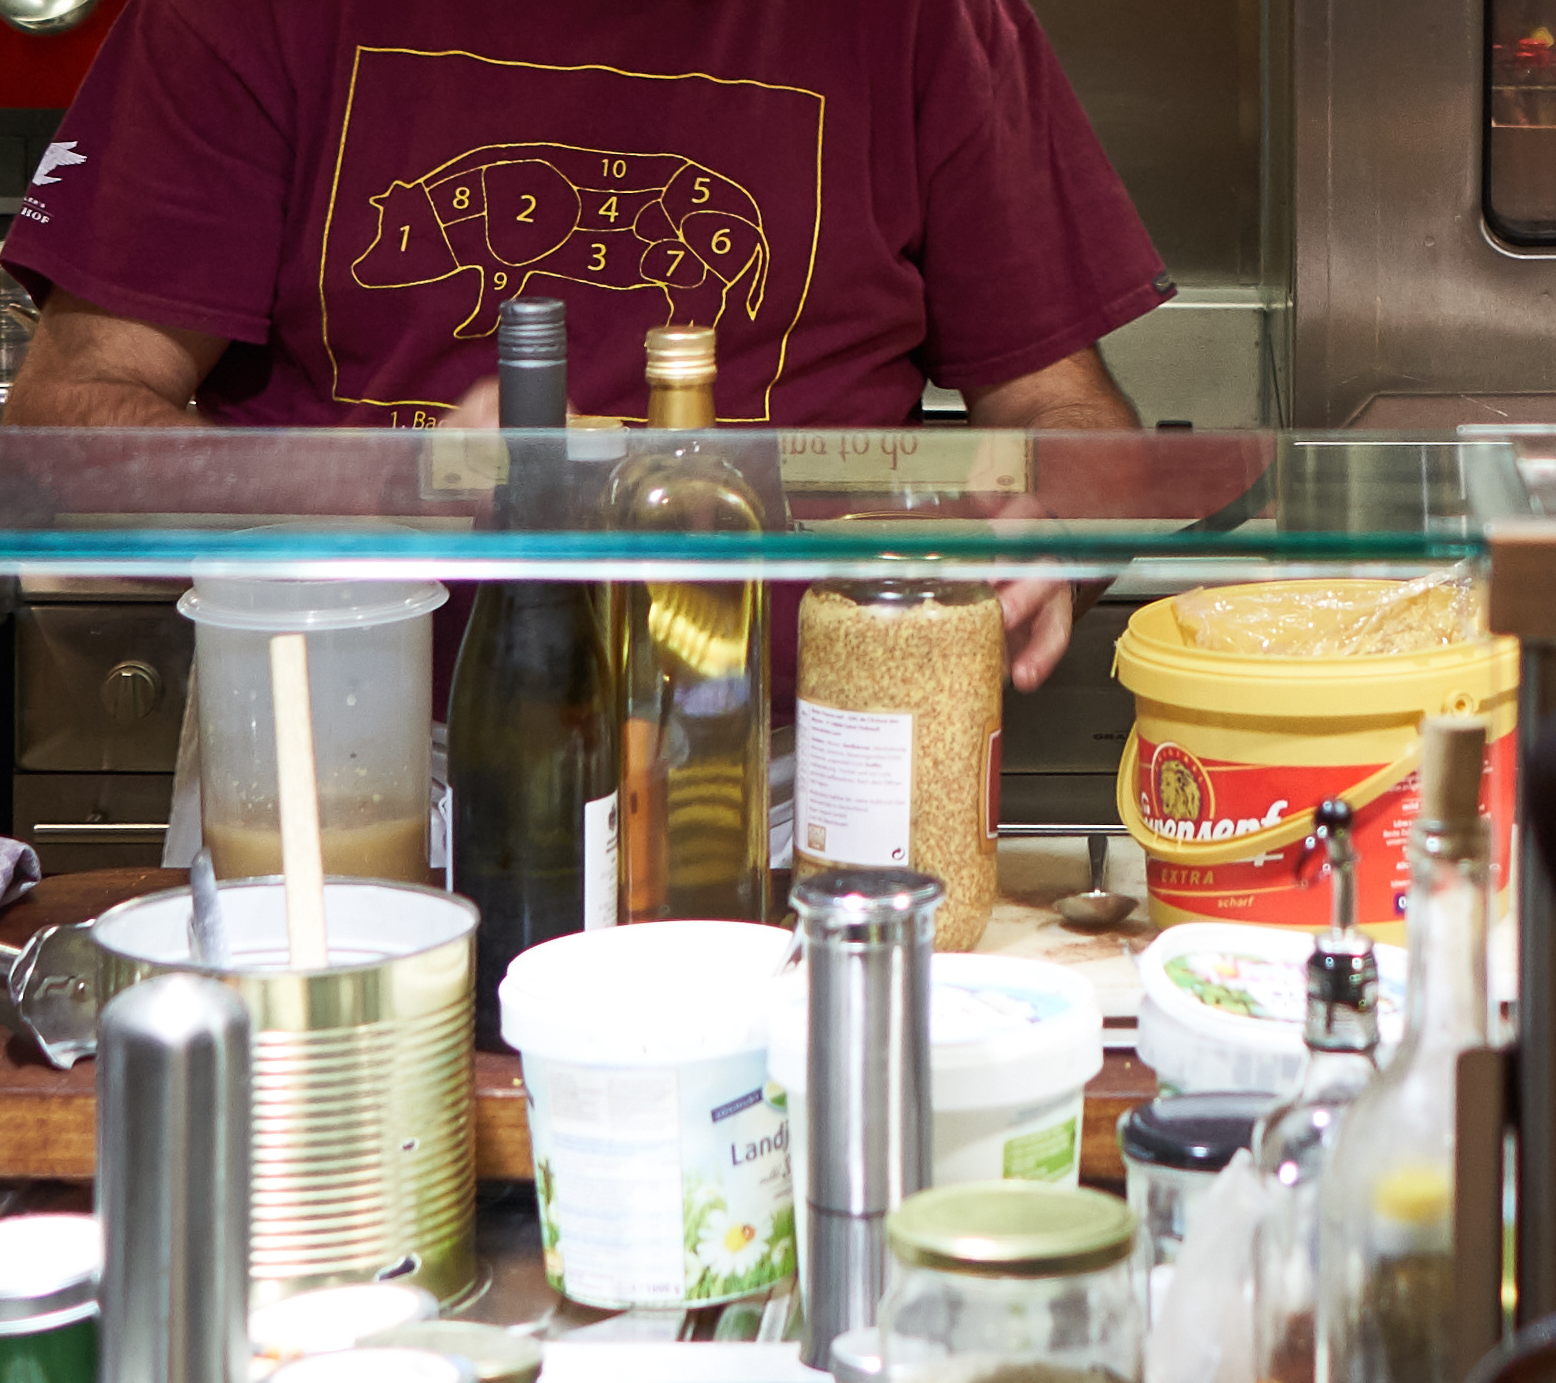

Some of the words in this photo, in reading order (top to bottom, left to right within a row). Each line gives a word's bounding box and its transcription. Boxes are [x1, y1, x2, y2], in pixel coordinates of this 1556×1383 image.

[601, 158, 628, 179] 10
[452, 186, 471, 210] 8
[691, 177, 711, 204] 5
[516, 195, 537, 223] 2
[598, 196, 620, 223] 4
[398, 224, 411, 252] 1
[710, 227, 732, 255] 6
[588, 243, 608, 271] 3
[665, 249, 686, 277] 7
[492, 271, 509, 292] 9
[1161, 868, 1215, 886] EXTRA
[1217, 895, 1256, 909] scharf
[730, 1118, 790, 1167] Landj
